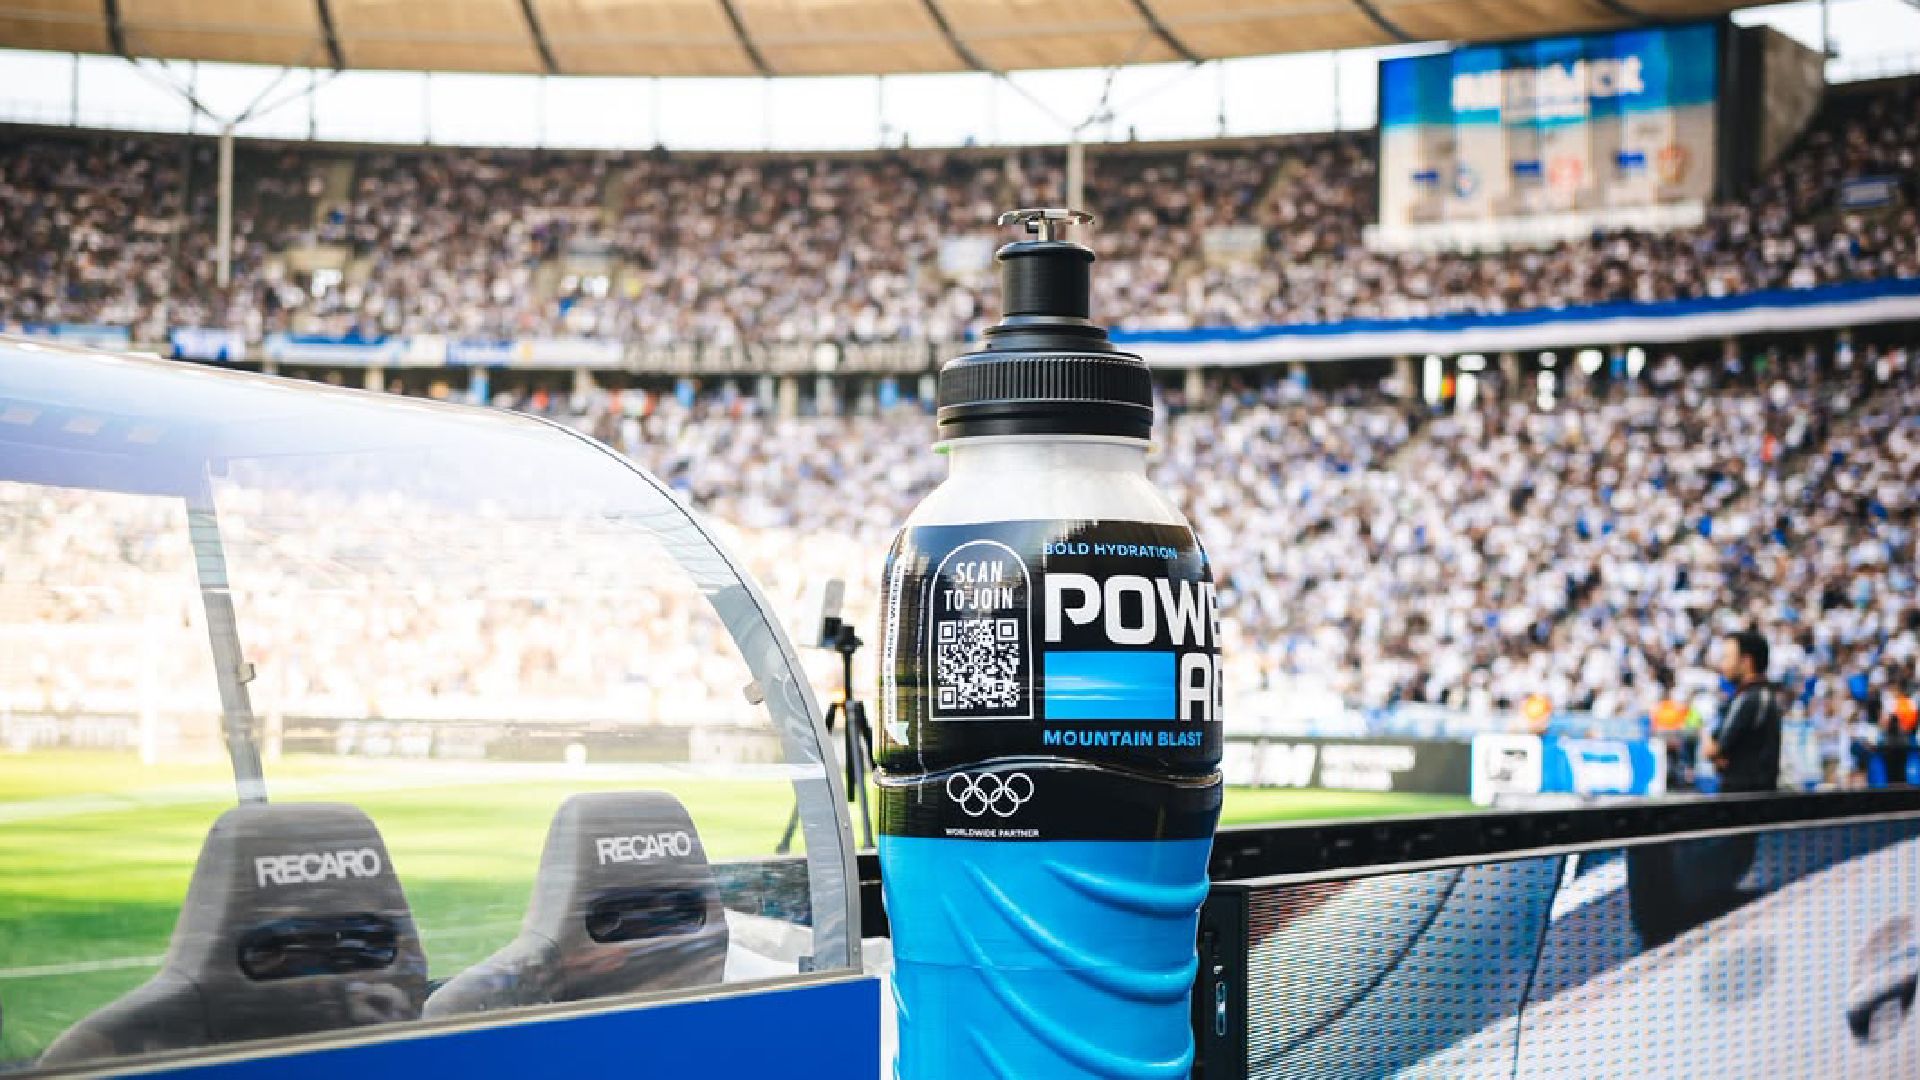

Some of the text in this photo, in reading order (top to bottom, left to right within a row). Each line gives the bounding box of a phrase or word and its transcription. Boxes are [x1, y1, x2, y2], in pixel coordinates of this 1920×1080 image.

[1043, 542, 1177, 560] BOLD HYDRATION
[955, 560, 1003, 582] SCAN
[944, 587, 1013, 611] TO JOIN
[1043, 729, 1202, 746] MOUNTAIN BLAST
[945, 828, 1040, 838] WORLDWIDE PARTNER
[595, 831, 691, 865] RECARO
[256, 848, 381, 888] RECARO
